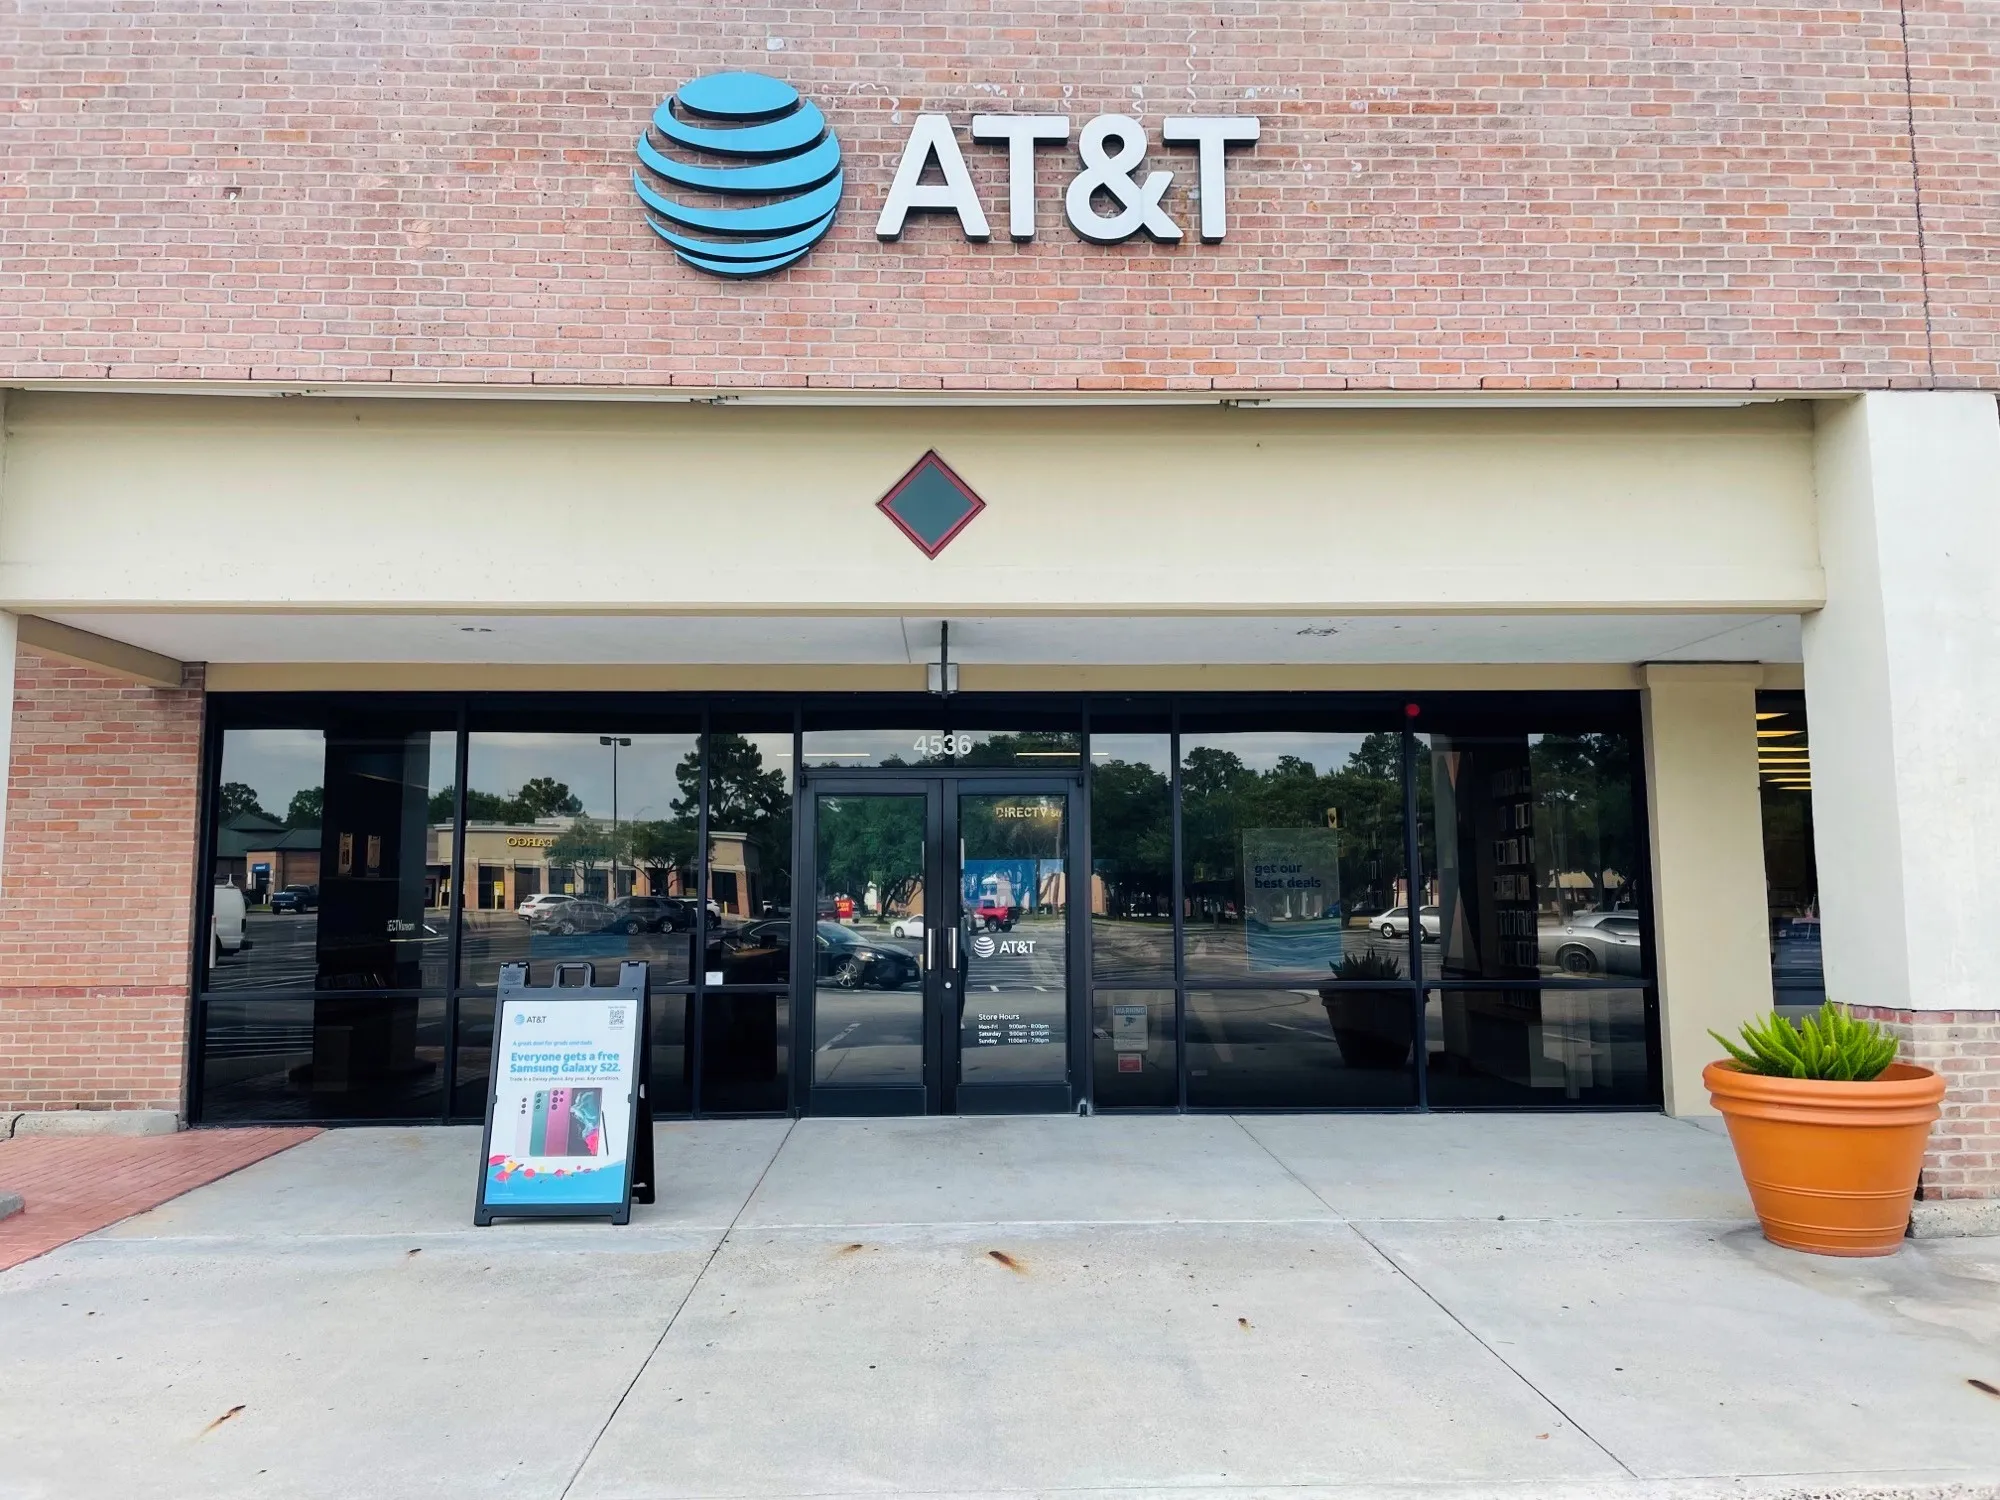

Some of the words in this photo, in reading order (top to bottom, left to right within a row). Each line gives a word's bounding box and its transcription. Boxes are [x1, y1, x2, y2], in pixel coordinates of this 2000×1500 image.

[875, 114, 1260, 243] AT&T
[913, 734, 972, 755] 4536
[995, 807, 1047, 818] DIRECTV
[1254, 864, 1276, 876] get
[1280, 864, 1302, 873] our
[1254, 877, 1283, 888] best
[1287, 877, 1322, 888] deals
[999, 940, 1037, 954] AT&T
[511, 1052, 561, 1063] Everyone
[563, 1052, 587, 1063] gets
[598, 1051, 619, 1060] free
[510, 1063, 559, 1075] Samsung
[561, 1063, 598, 1074] Galaxy
[600, 1063, 620, 1072] S22.
